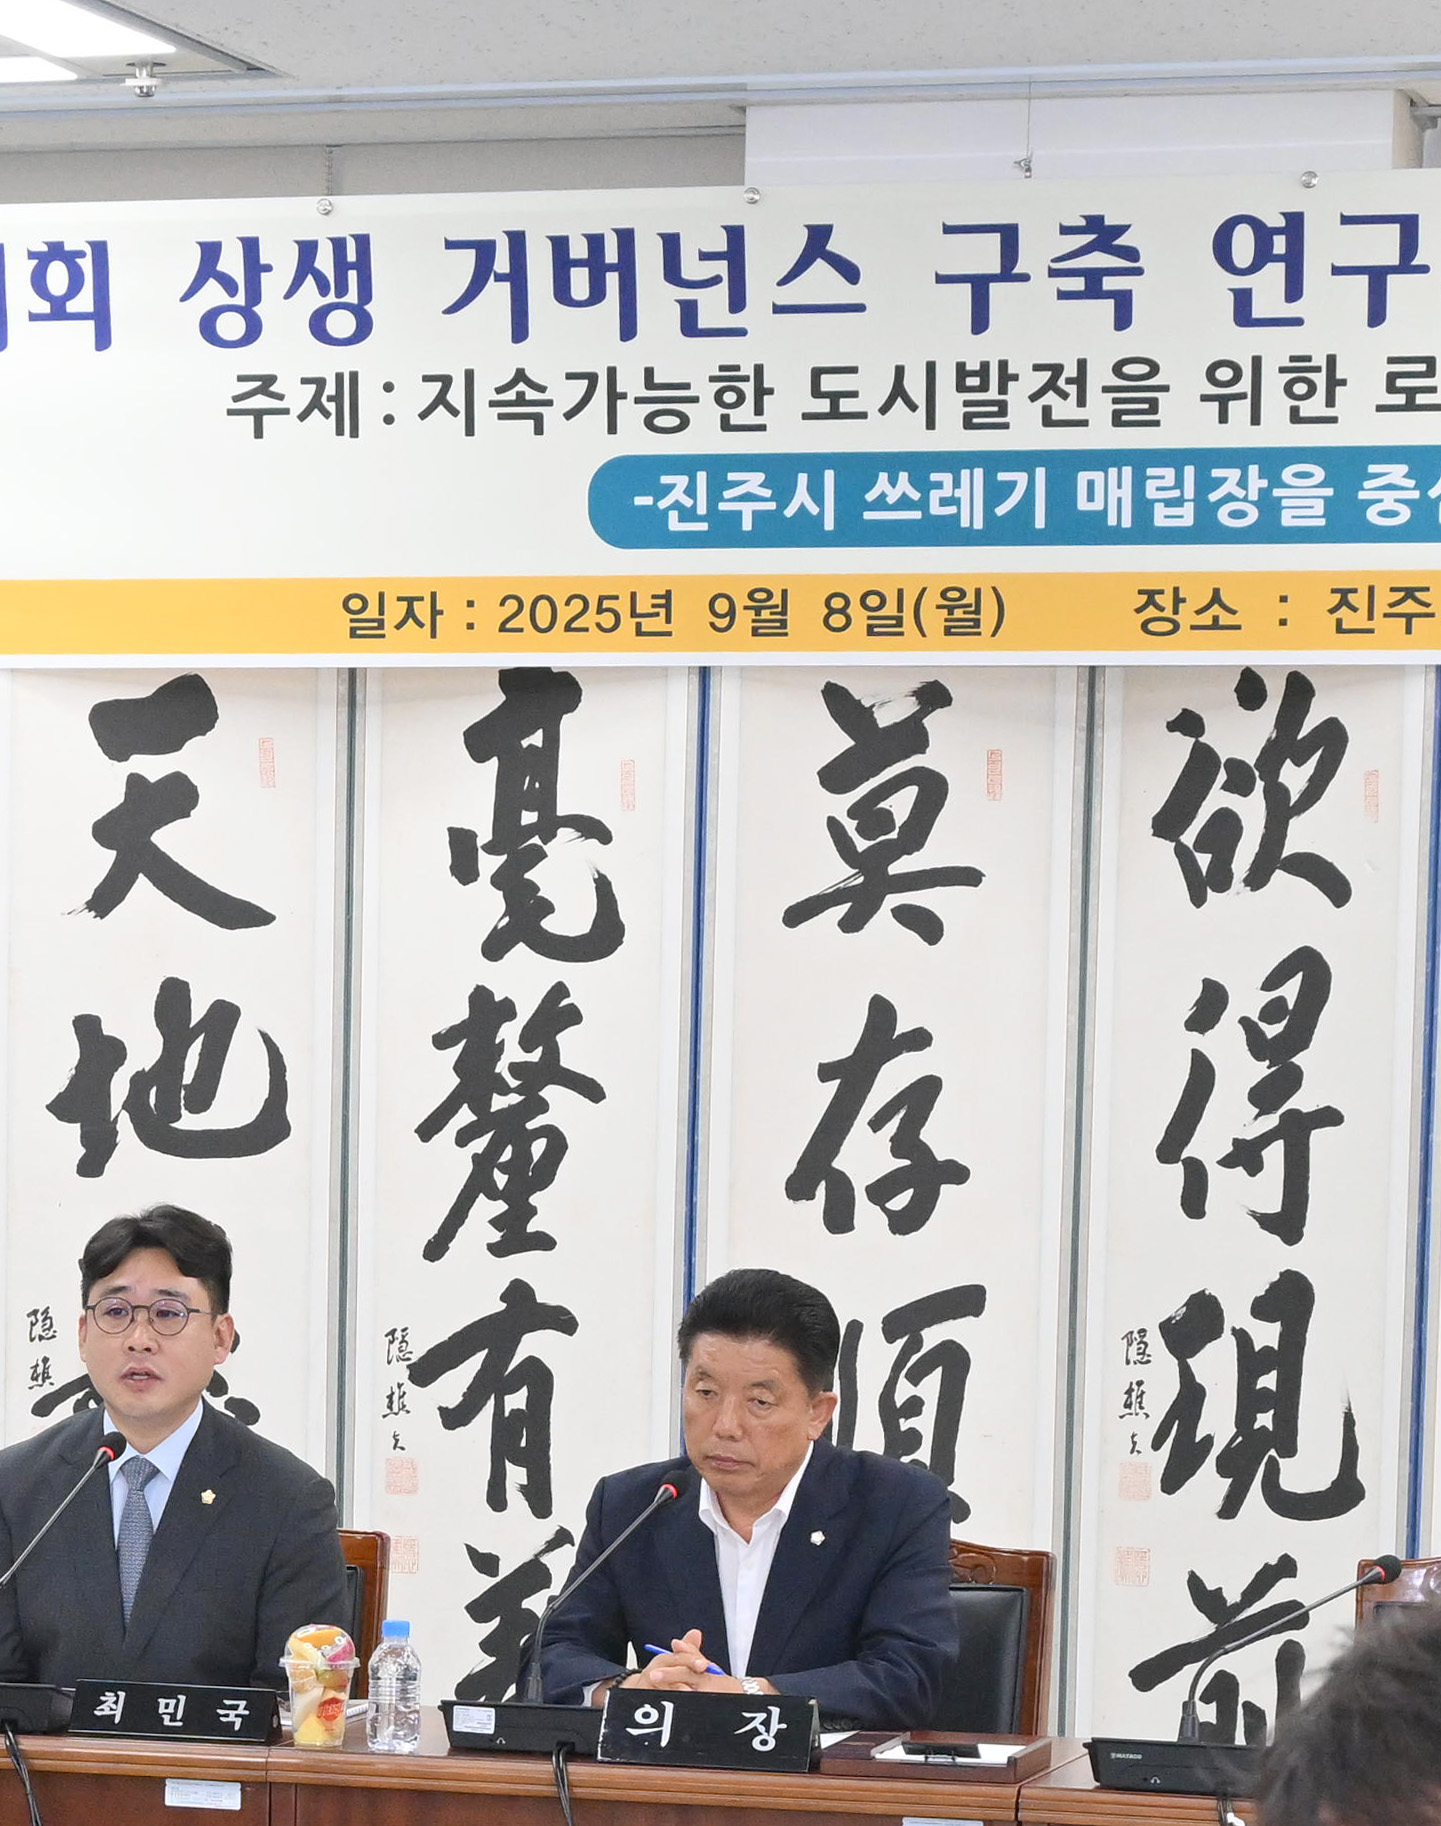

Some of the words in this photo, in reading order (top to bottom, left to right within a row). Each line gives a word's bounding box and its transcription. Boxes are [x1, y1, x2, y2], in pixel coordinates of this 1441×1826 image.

[180, 234, 375, 350] 상생
[442, 224, 868, 346] 거버넌스
[935, 215, 1146, 337] 구축
[418, 364, 777, 438] 지속가능한
[801, 358, 1171, 433] 도시발전을
[1200, 354, 1350, 427] 위한
[864, 468, 1047, 531] 쓰레기
[1078, 464, 1335, 529] 매립장을
[343, 592, 445, 640] 일자
[499, 590, 674, 638] 2025년
[709, 588, 790, 638] 9월
[823, 587, 1006, 639] 8일(월)
[1134, 586, 1243, 638] 장소
